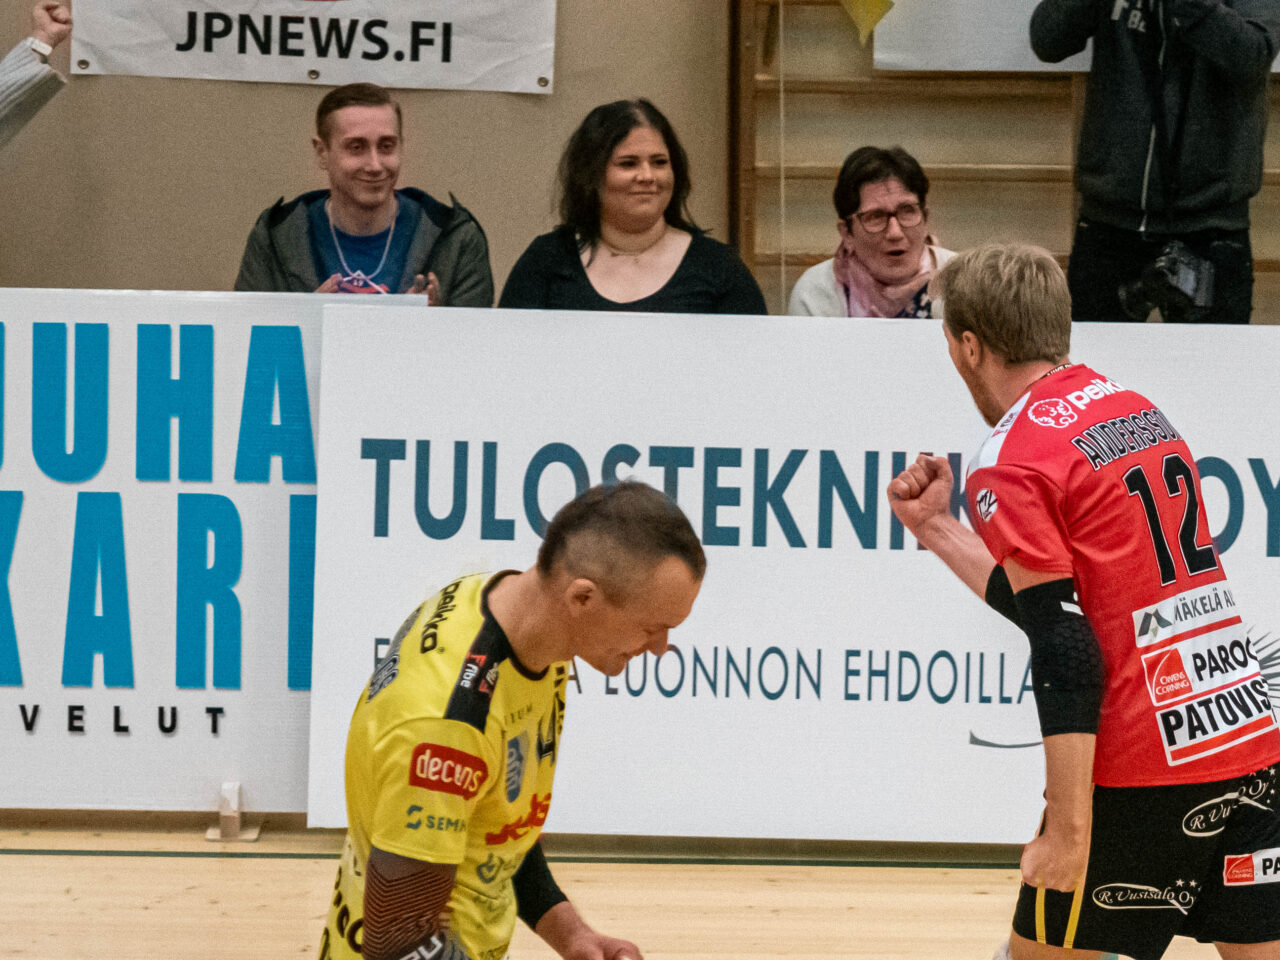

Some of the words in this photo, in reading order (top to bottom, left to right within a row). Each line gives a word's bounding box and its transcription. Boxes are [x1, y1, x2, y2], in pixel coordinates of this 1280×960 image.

[176, 11, 453, 63] JPNEWS.FI
[0, 321, 318, 483] UHA
[1065, 378, 1125, 410] peik
[1122, 453, 1219, 587] 12
[1156, 680, 1190, 696] CORNING
[1160, 677, 1277, 747] PATOVIS
